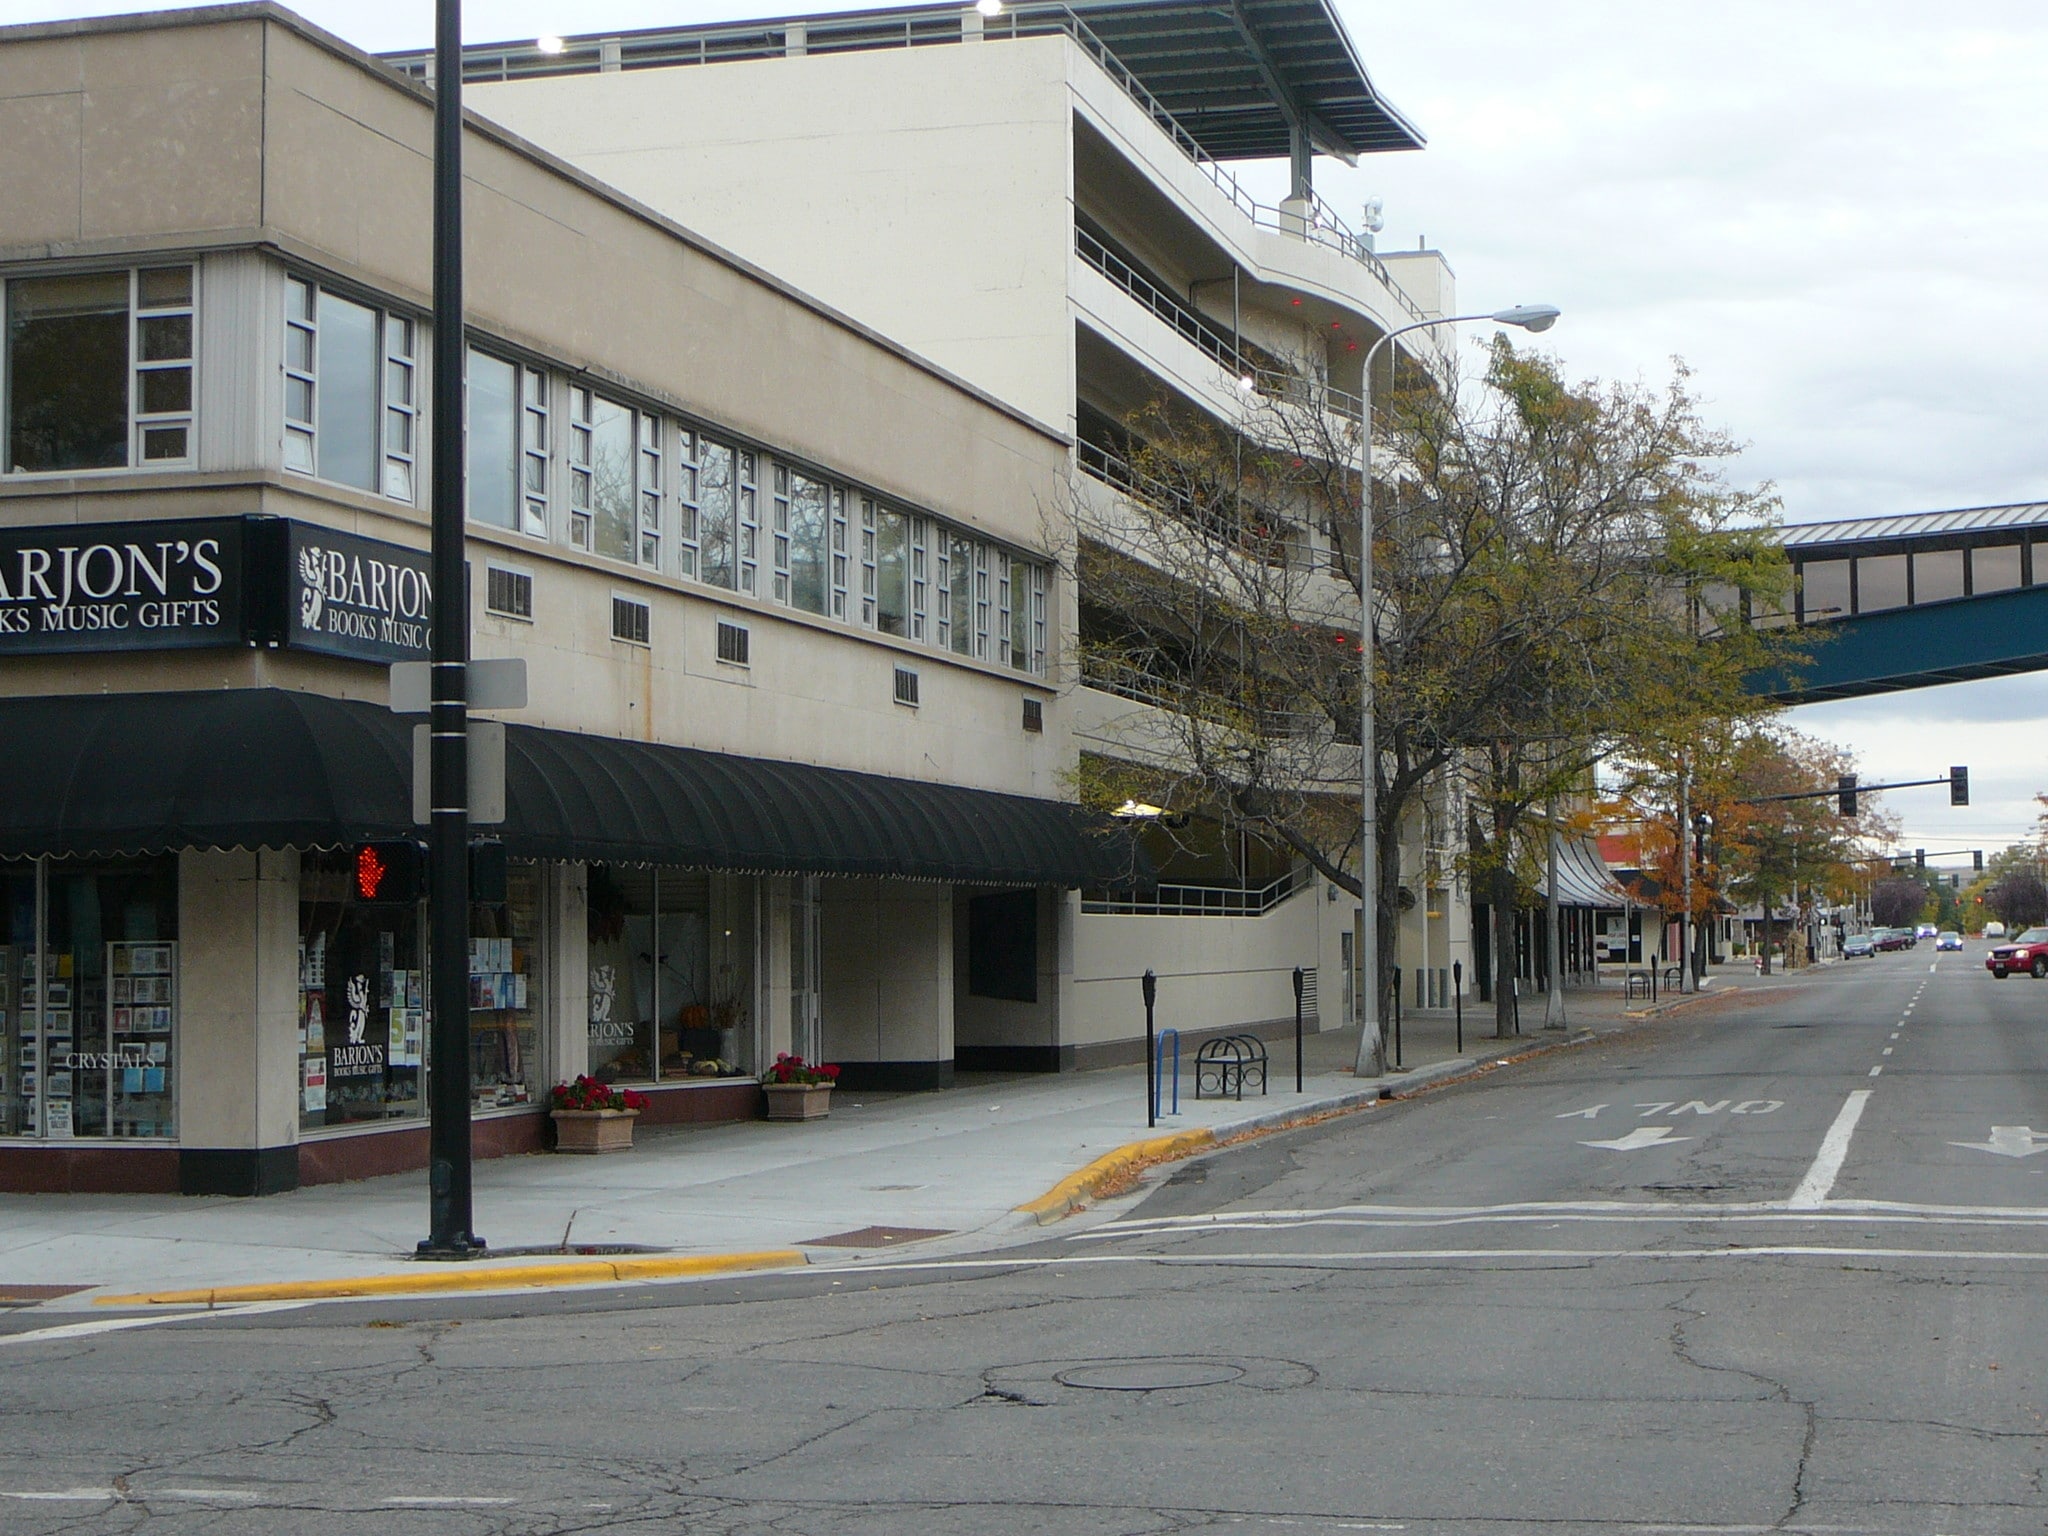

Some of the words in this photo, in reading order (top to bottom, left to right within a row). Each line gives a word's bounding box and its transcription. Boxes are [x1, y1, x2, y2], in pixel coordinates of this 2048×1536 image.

[40, 603, 129, 632] MUSIC
[138, 599, 220, 628] GIFTS
[328, 608, 377, 641] BOOKS
[380, 616, 422, 649] MUSIC
[66, 1053, 156, 1069] CRYSTALS
[334, 1045, 383, 1067] BARJON'S
[1555, 1100, 1785, 1119] ONLY
